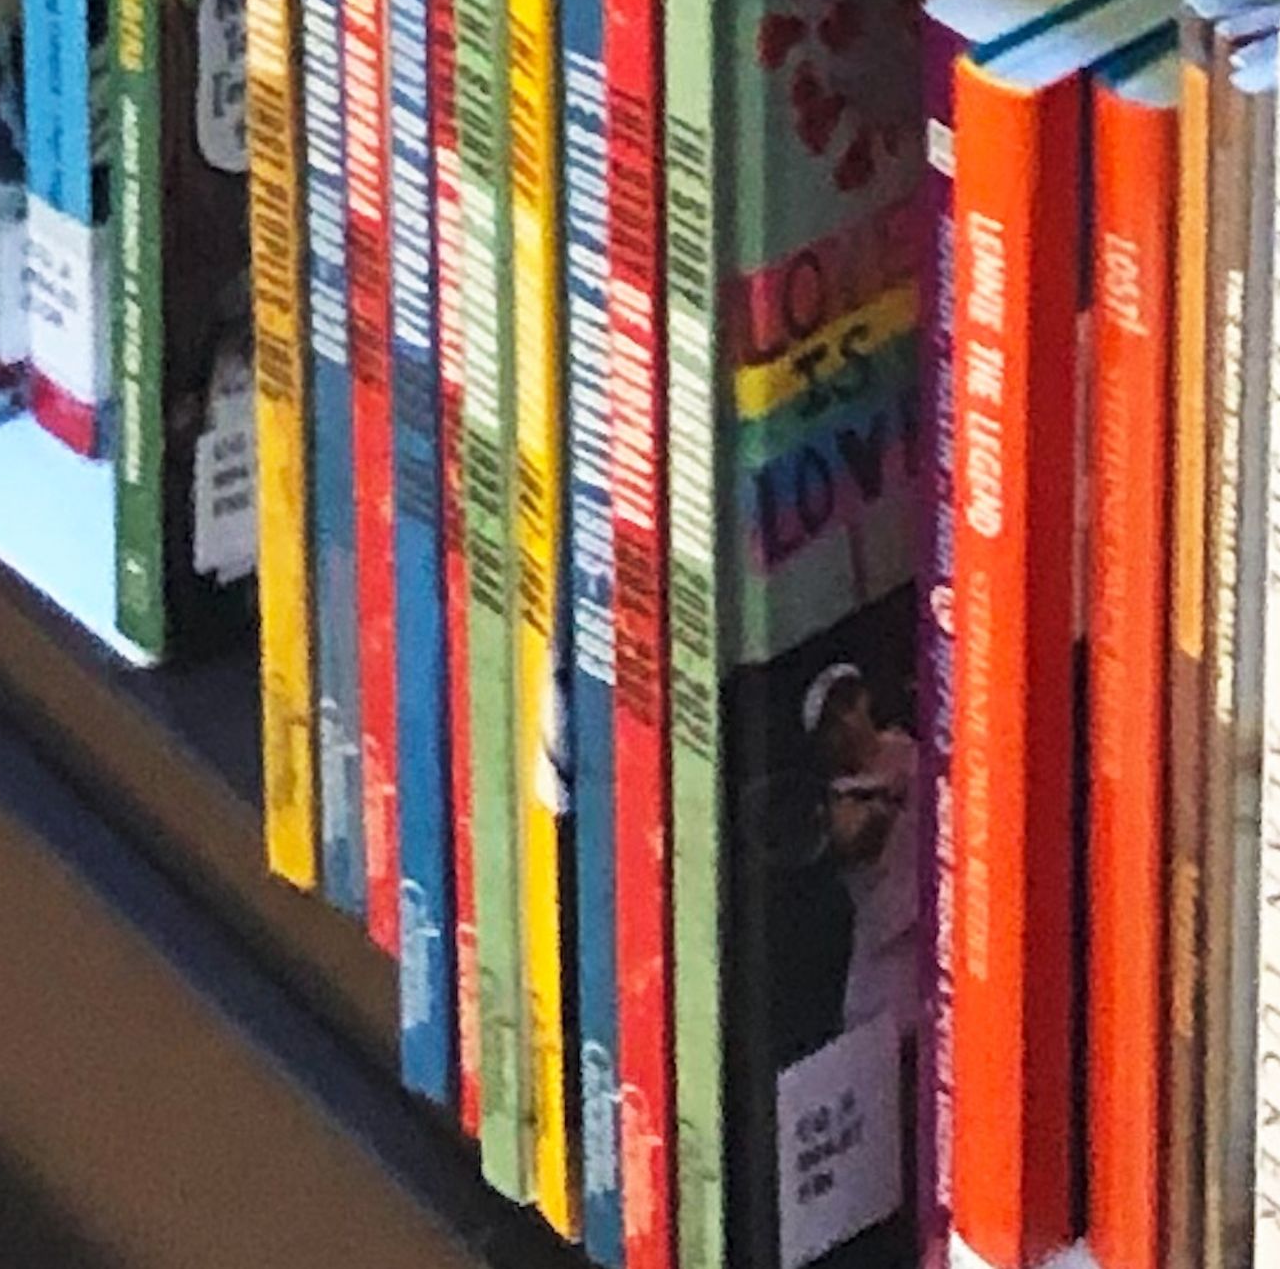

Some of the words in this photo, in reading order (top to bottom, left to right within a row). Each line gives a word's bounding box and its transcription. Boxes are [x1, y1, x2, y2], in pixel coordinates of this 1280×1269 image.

[344, 31, 384, 223] AUSTRALIA
[392, 104, 430, 163] OF
[564, 49, 609, 122] THE
[566, 122, 611, 246] STORY
[668, 115, 709, 181] THE
[394, 160, 431, 350] AUSTRALIA
[569, 244, 613, 299] OF
[612, 279, 654, 332] OF
[669, 181, 710, 315] STORY
[967, 211, 1007, 332] LENNIE
[669, 307, 712, 364] OF
[966, 340, 1003, 407] THE
[571, 299, 616, 497] AUSTRALIA
[613, 331, 657, 531] AUSTRALIA
[670, 362, 713, 564] AUSTRALIA
[965, 411, 1003, 538] LEGEND
